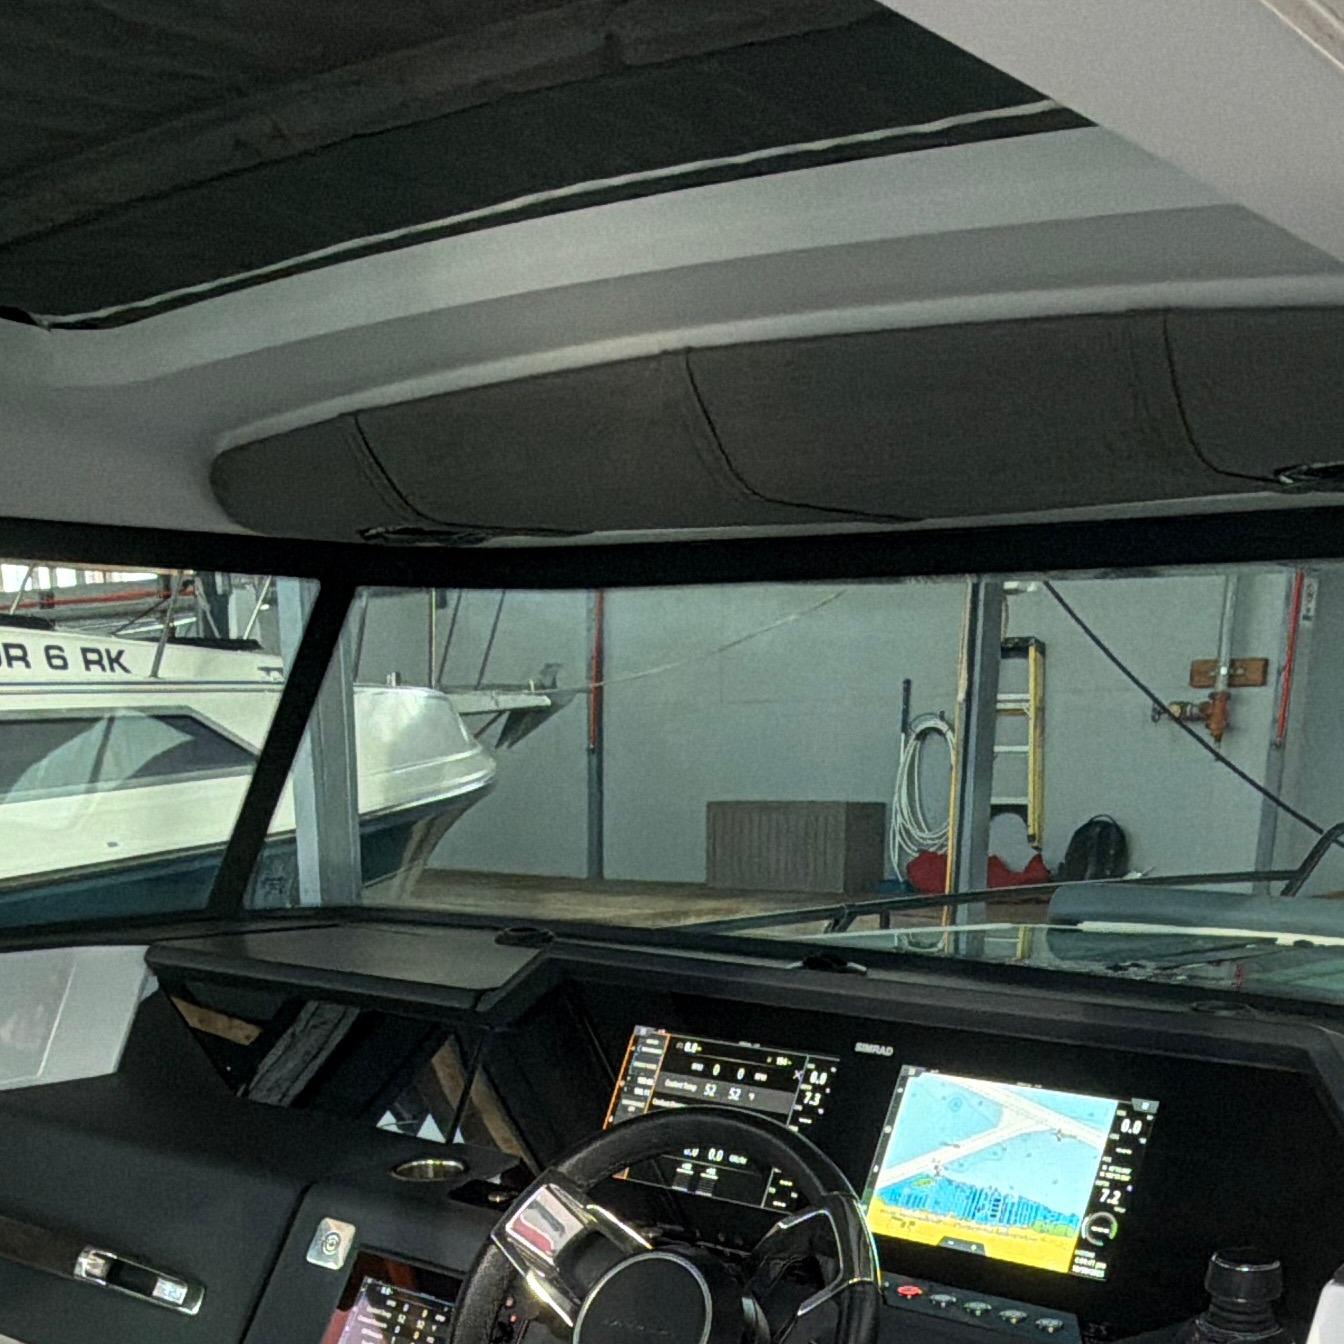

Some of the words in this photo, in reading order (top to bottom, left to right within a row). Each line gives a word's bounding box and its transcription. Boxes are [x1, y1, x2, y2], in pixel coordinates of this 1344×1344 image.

[44, 644, 69, 671] 6
[80, 646, 132, 674] RK
[854, 1041, 894, 1058] SIMRAD
[803, 1091, 822, 1106] 7.3
[1120, 1118, 1143, 1135] 0.0
[1099, 1188, 1122, 1205] 7.2
